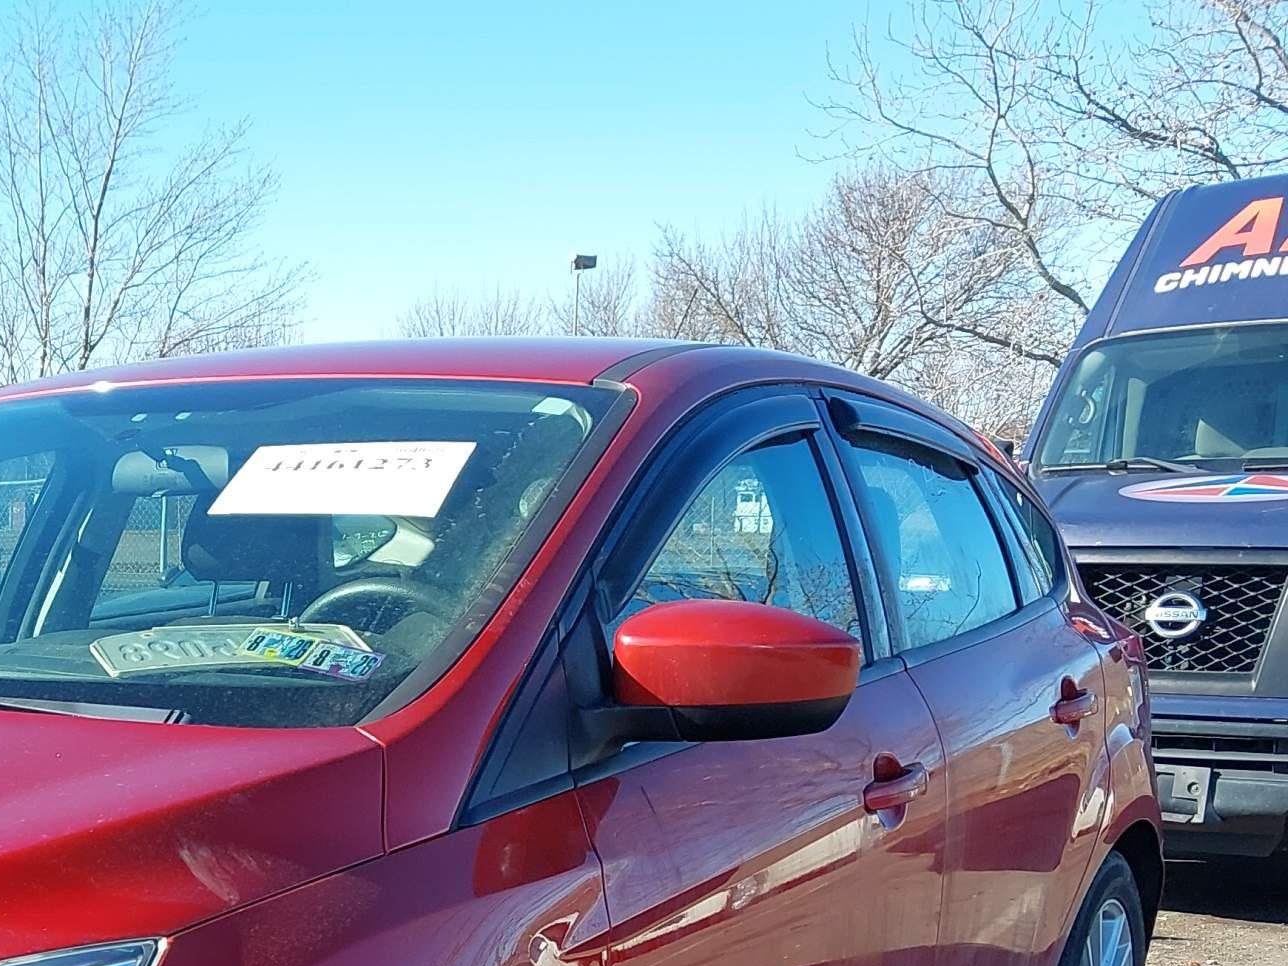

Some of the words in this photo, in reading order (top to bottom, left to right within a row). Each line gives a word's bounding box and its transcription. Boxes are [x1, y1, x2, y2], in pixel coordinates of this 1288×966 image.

[1179, 196, 1288, 267] A
[264, 457, 433, 472] 44161273
[247, 635, 266, 652] 8
[287, 639, 314, 661] 26
[313, 649, 331, 667] 8
[351, 654, 379, 677] 26
